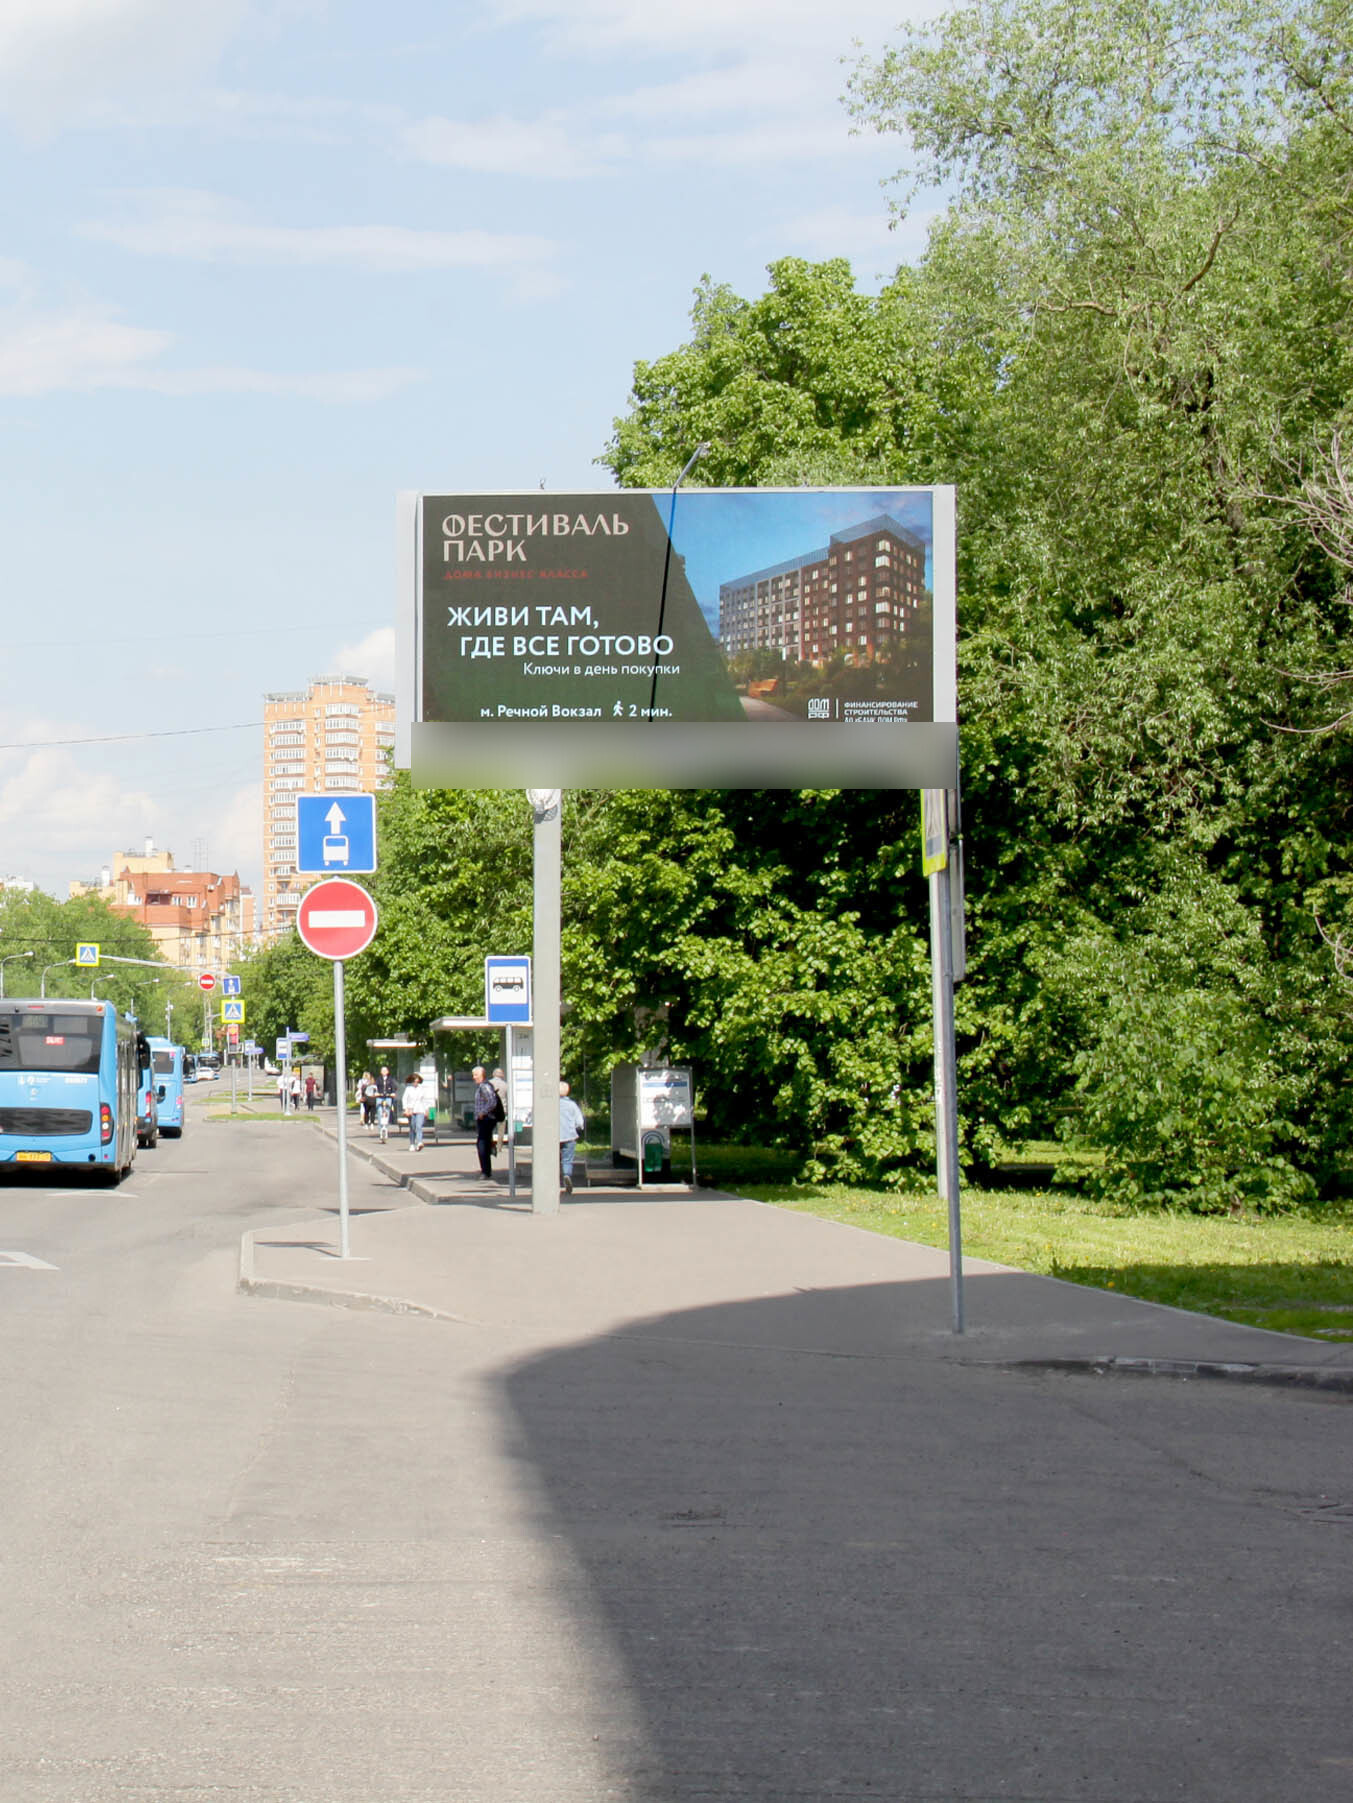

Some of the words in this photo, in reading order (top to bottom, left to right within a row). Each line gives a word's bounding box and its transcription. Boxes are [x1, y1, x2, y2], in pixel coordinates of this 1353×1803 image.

[442, 513, 629, 537] ФЕСТИВАЛЬ
[443, 540, 527, 562] ПАРК
[448, 606, 529, 627] ЖИВИ
[535, 606, 599, 629] ТАМ,
[460, 636, 505, 659] ГДЕ
[513, 636, 560, 656] ВСЕ
[567, 635, 674, 656] ГОТОВО
[523, 662, 570, 675] Ключи
[573, 665, 582, 675] в
[584, 665, 618, 677] день
[621, 665, 680, 679] покупки
[480, 708, 494, 718] м.
[497, 704, 548, 718] Речной
[552, 705, 602, 718] Вокзал
[629, 705, 638, 718] 2
[641, 708, 673, 718] мин.
[844, 701, 919, 709] ФИНАНСИРОВАНИЕ
